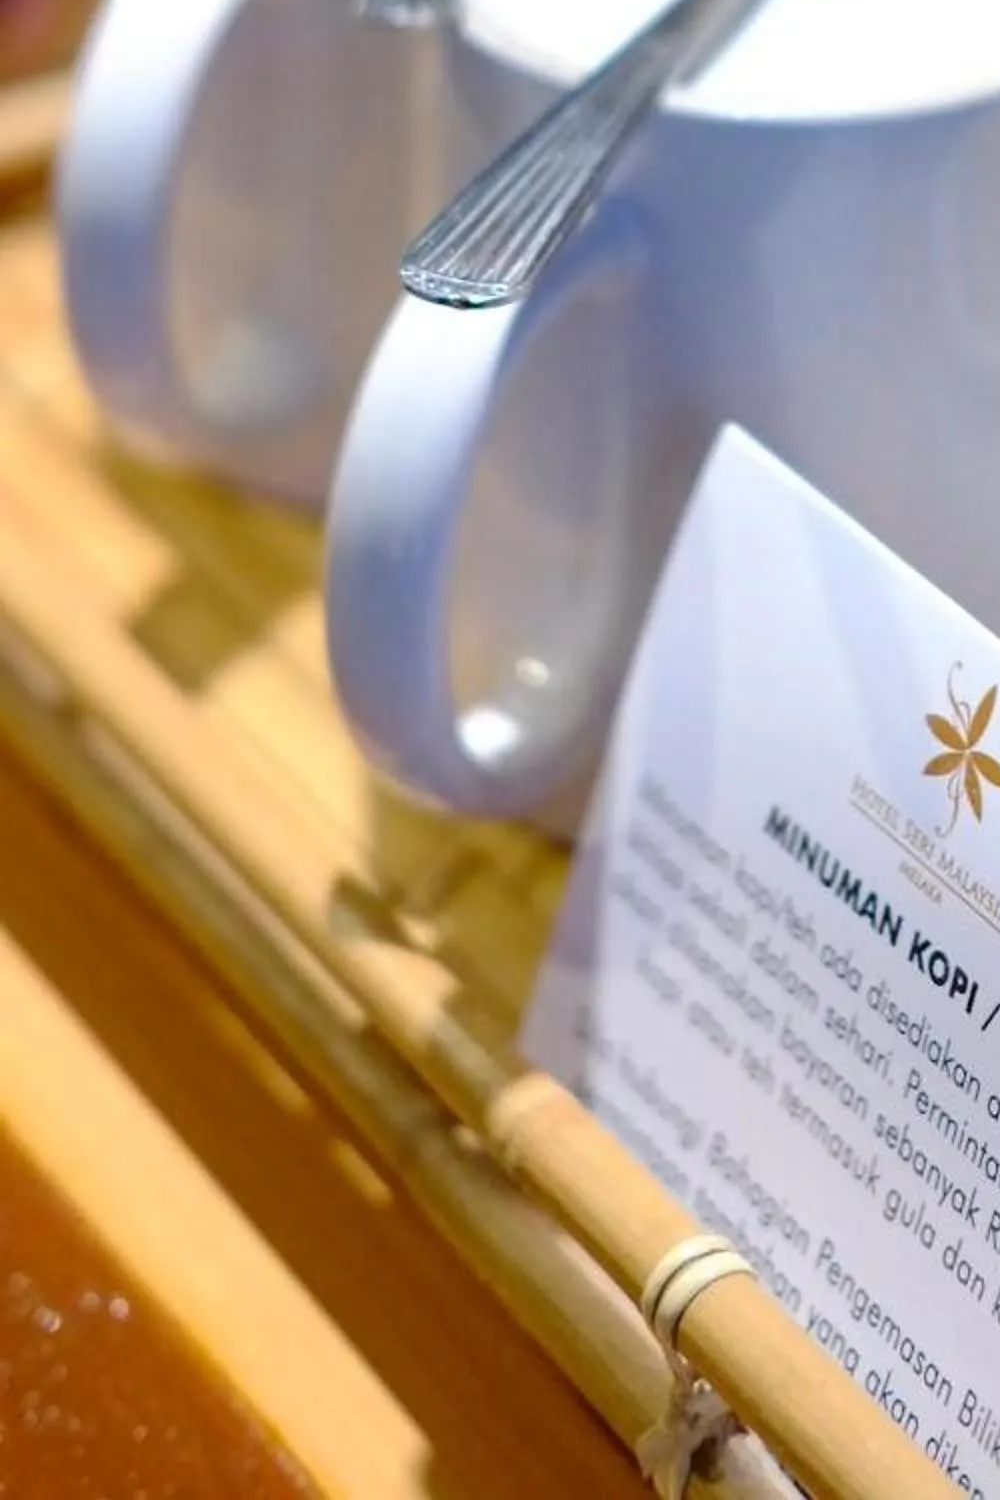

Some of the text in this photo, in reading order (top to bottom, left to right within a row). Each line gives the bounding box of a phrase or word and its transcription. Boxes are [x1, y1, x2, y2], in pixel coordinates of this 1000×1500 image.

[762, 805, 905, 947] MINUMAN
[908, 931, 979, 1015] KOPI
[820, 944, 864, 993] ada
[866, 979, 982, 1102] disediakan
[823, 1006, 895, 1087] sehari.
[778, 1082, 881, 1196] termasuk
[882, 1188, 938, 1251] gula
[942, 1237, 987, 1303] dan
[780, 1012, 869, 1122] bayaran
[873, 1112, 981, 1230] sebanyak
[814, 1235, 954, 1408] Pengemasan
[865, 1367, 920, 1440] akan
